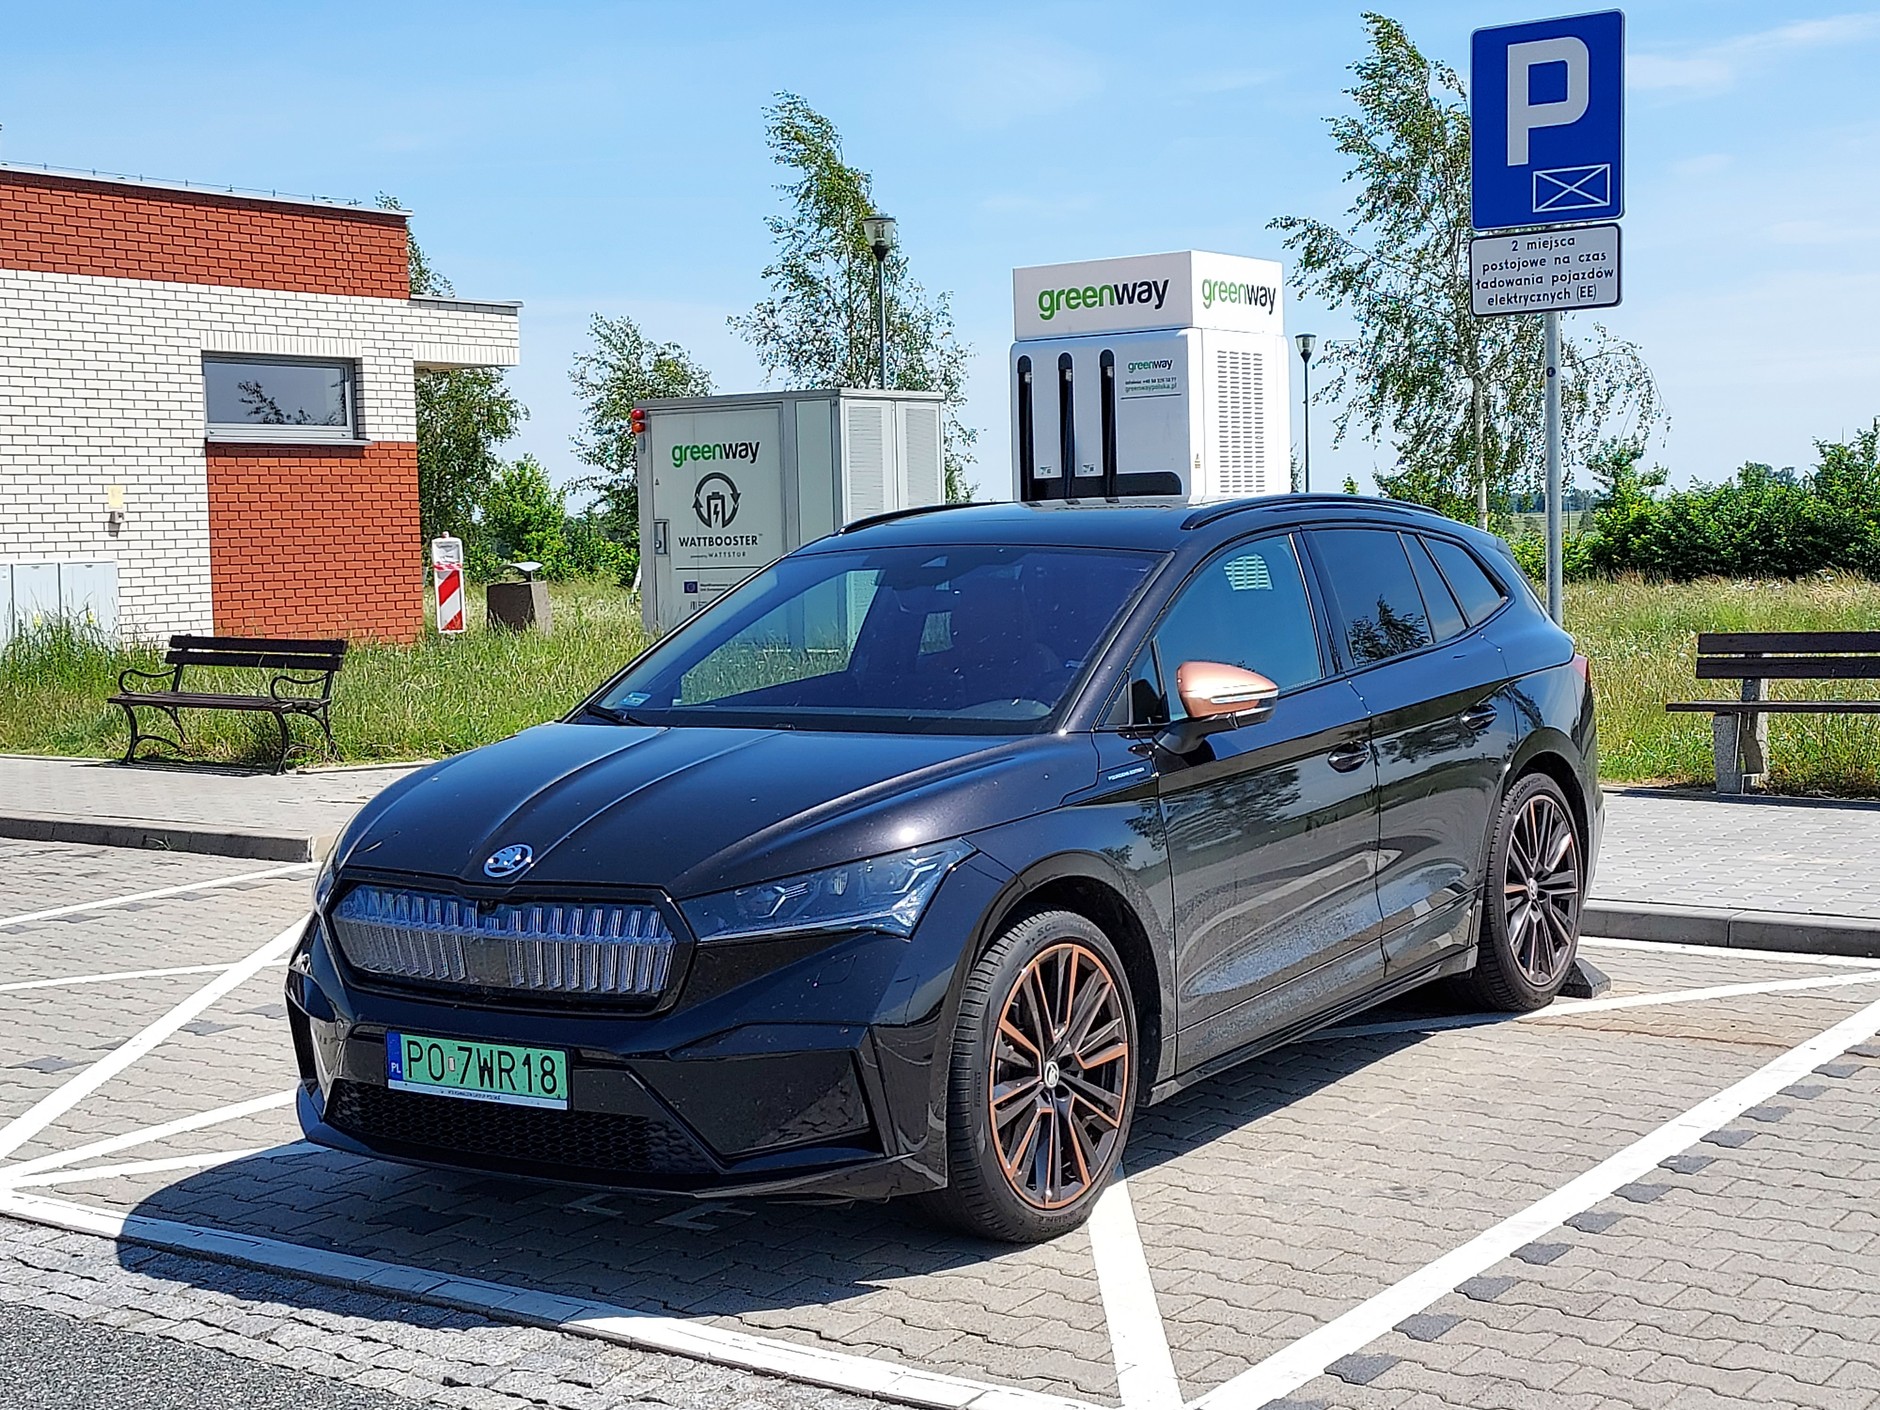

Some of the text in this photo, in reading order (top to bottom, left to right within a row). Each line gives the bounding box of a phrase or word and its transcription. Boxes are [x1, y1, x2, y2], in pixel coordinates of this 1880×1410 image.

[1507, 36, 1589, 167] P
[1511, 237, 1576, 252] 2 miejsca
[1482, 251, 1607, 276] postojowe na czas
[1475, 266, 1615, 290] ładowania pojazdów
[1038, 279, 1170, 321] greenway
[1202, 278, 1277, 316] greenway
[1487, 283, 1598, 307] elektrycznych (EE)
[1128, 359, 1173, 374] greenway
[671, 441, 761, 469] greenway
[678, 535, 759, 548] WATTBOOSTER
[390, 1062, 402, 1074] PL
[456, 1046, 558, 1095] 7WR18
